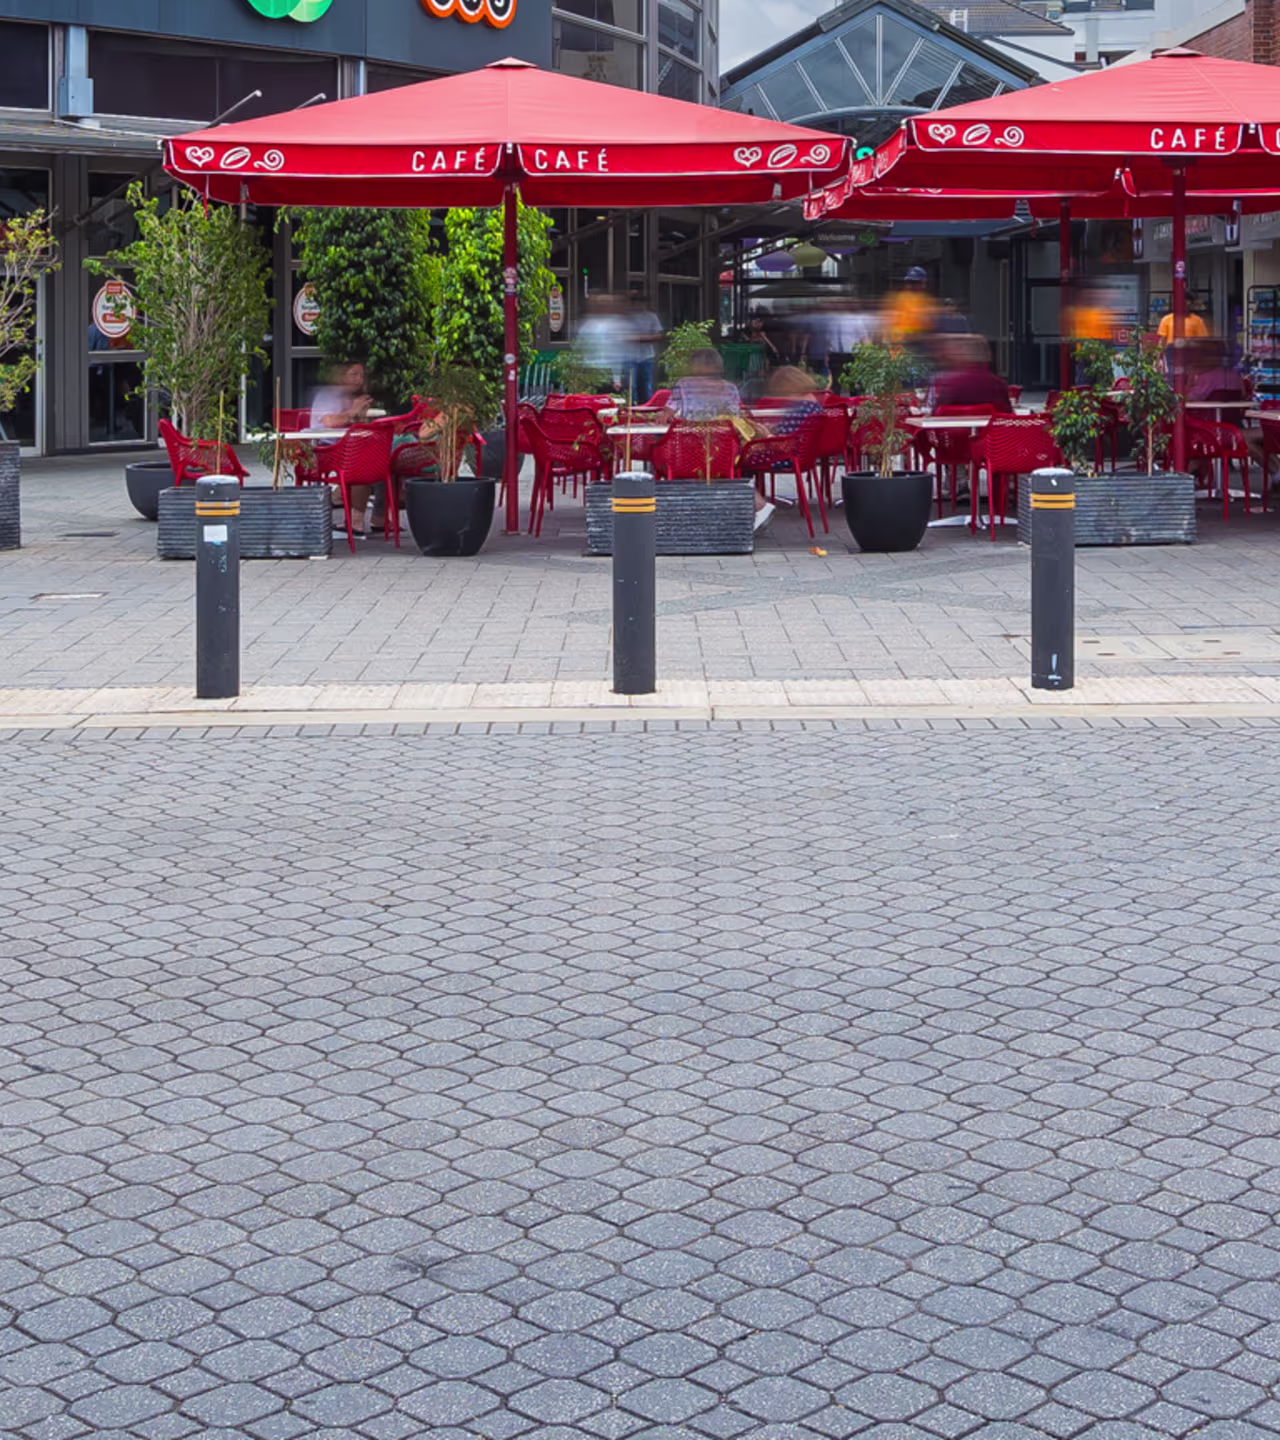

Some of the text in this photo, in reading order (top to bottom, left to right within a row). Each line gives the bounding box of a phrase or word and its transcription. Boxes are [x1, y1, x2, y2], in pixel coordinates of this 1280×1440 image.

[1151, 126, 1225, 150] CAFÉ
[412, 147, 485, 171] CAFÉ
[535, 148, 608, 172] CAFÉ
